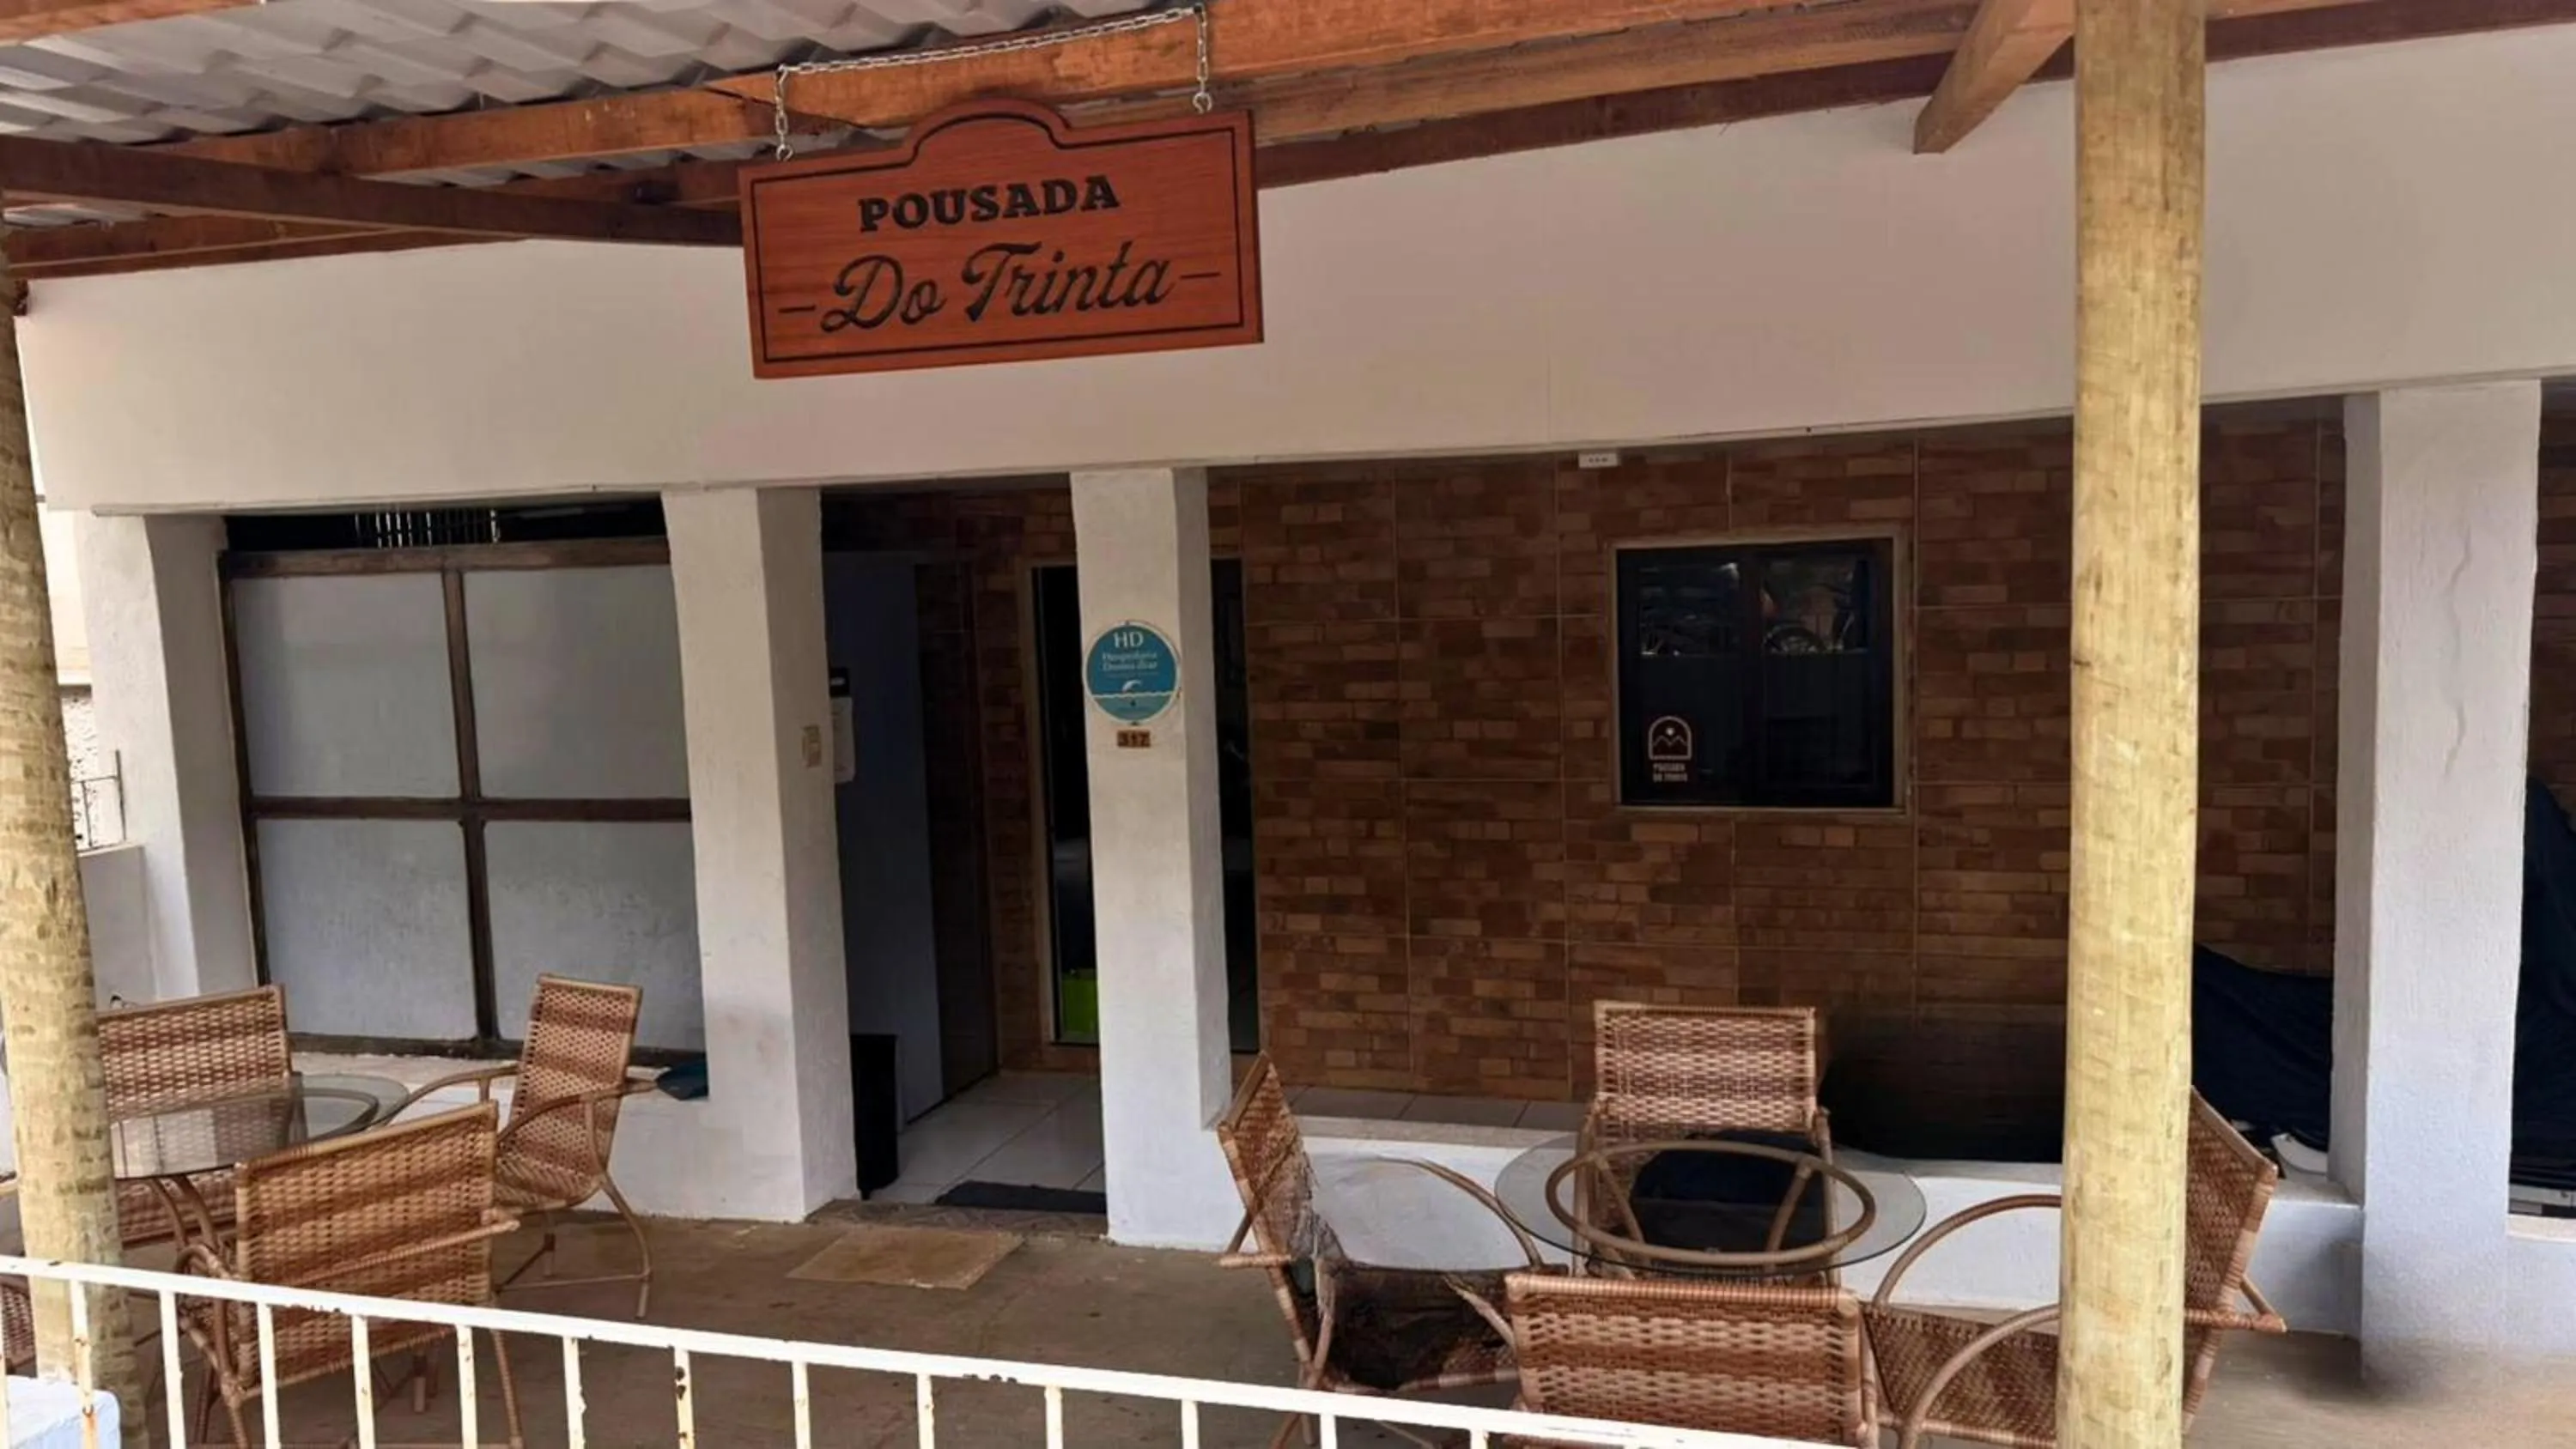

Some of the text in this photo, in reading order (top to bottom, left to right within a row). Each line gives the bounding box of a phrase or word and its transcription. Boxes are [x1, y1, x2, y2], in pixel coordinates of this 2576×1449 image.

[859, 175, 1120, 232] POUSADA
[819, 239, 1176, 333] Do Trinta
[1113, 631, 1145, 649] HD
